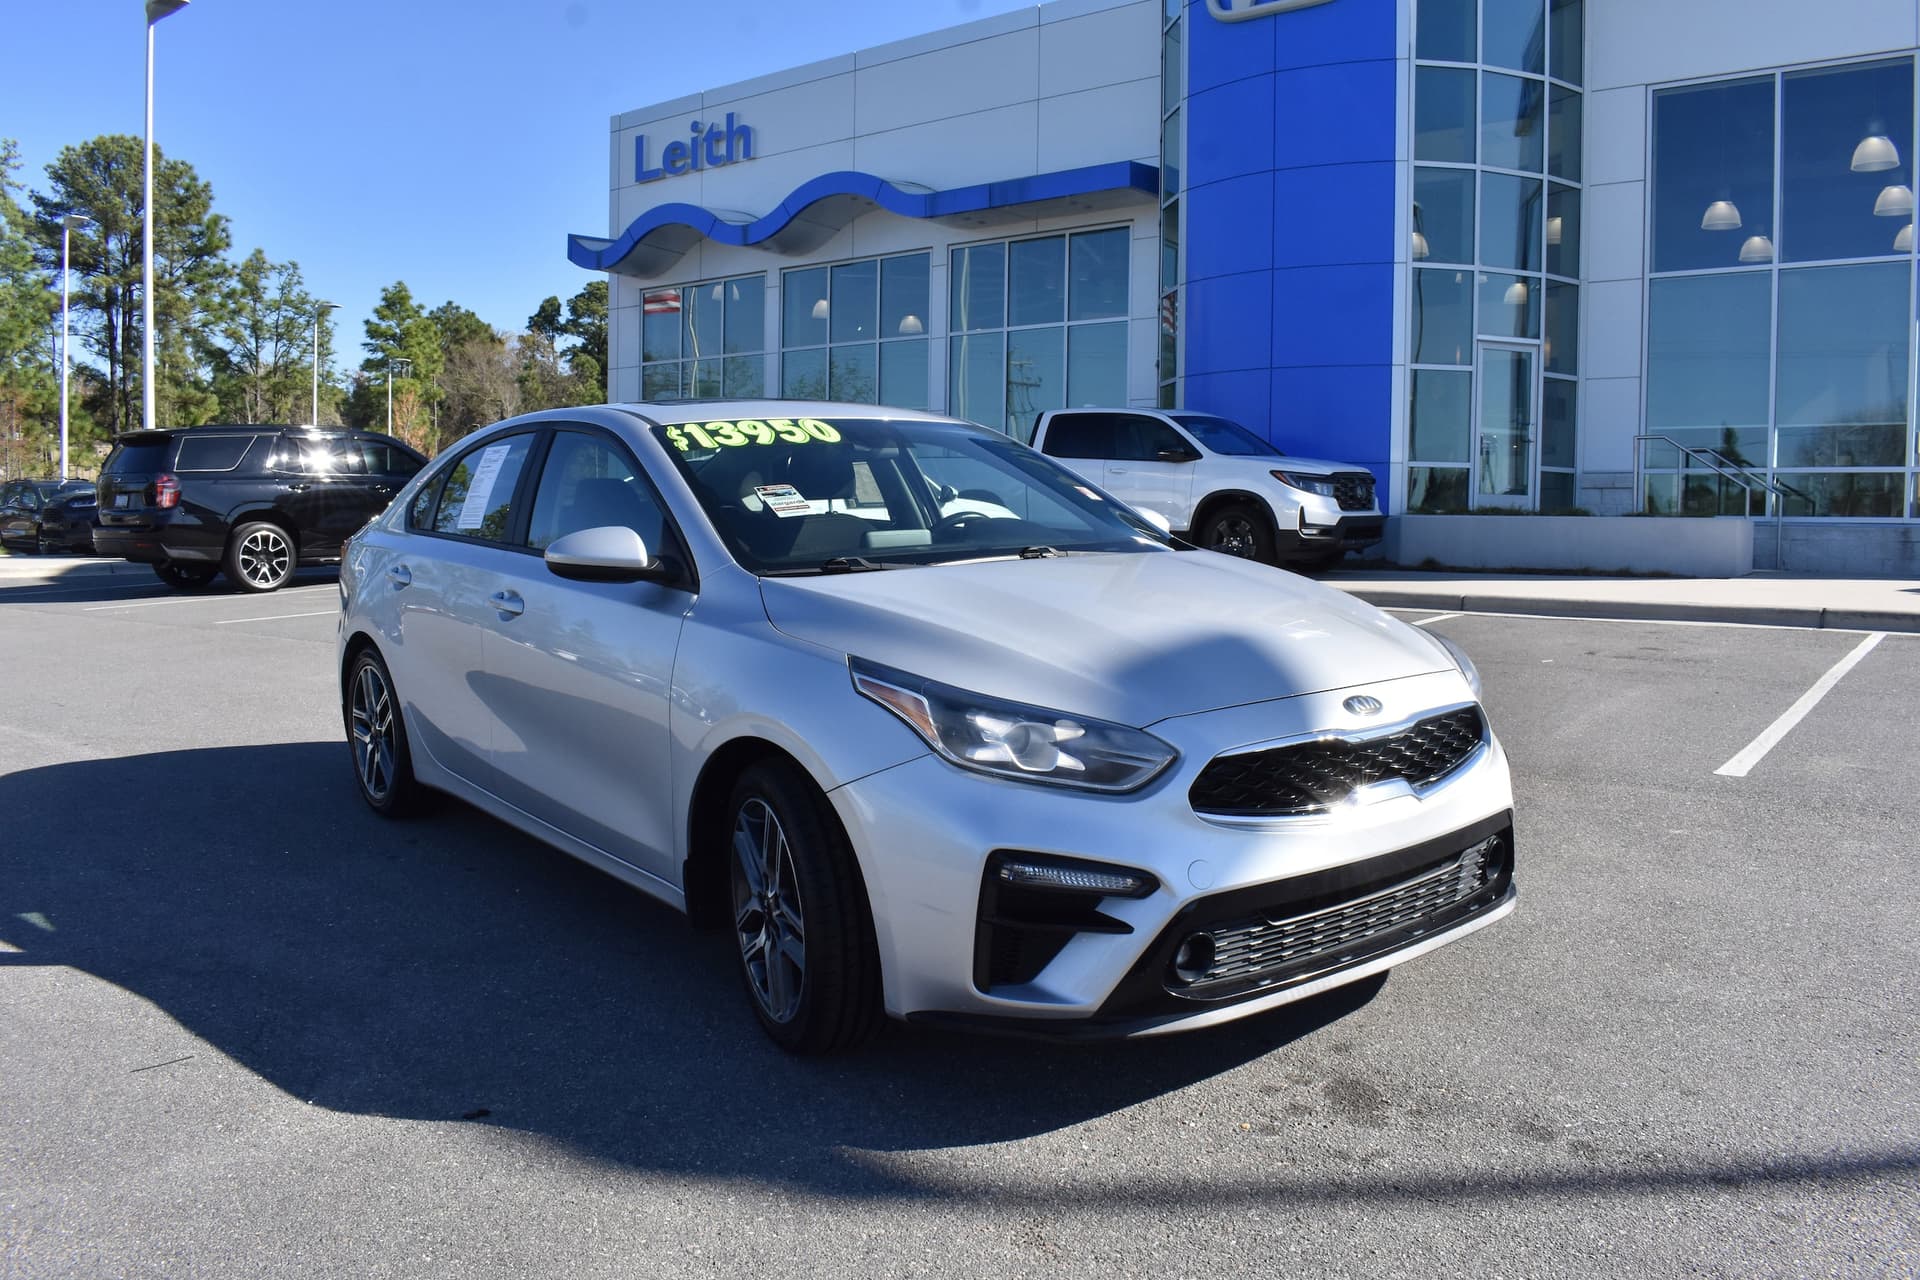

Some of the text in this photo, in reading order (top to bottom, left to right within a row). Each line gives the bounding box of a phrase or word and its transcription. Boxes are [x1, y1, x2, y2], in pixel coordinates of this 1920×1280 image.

[635, 112, 752, 183] Leith
[666, 418, 841, 451] $13950
[1347, 697, 1381, 713] KIA
